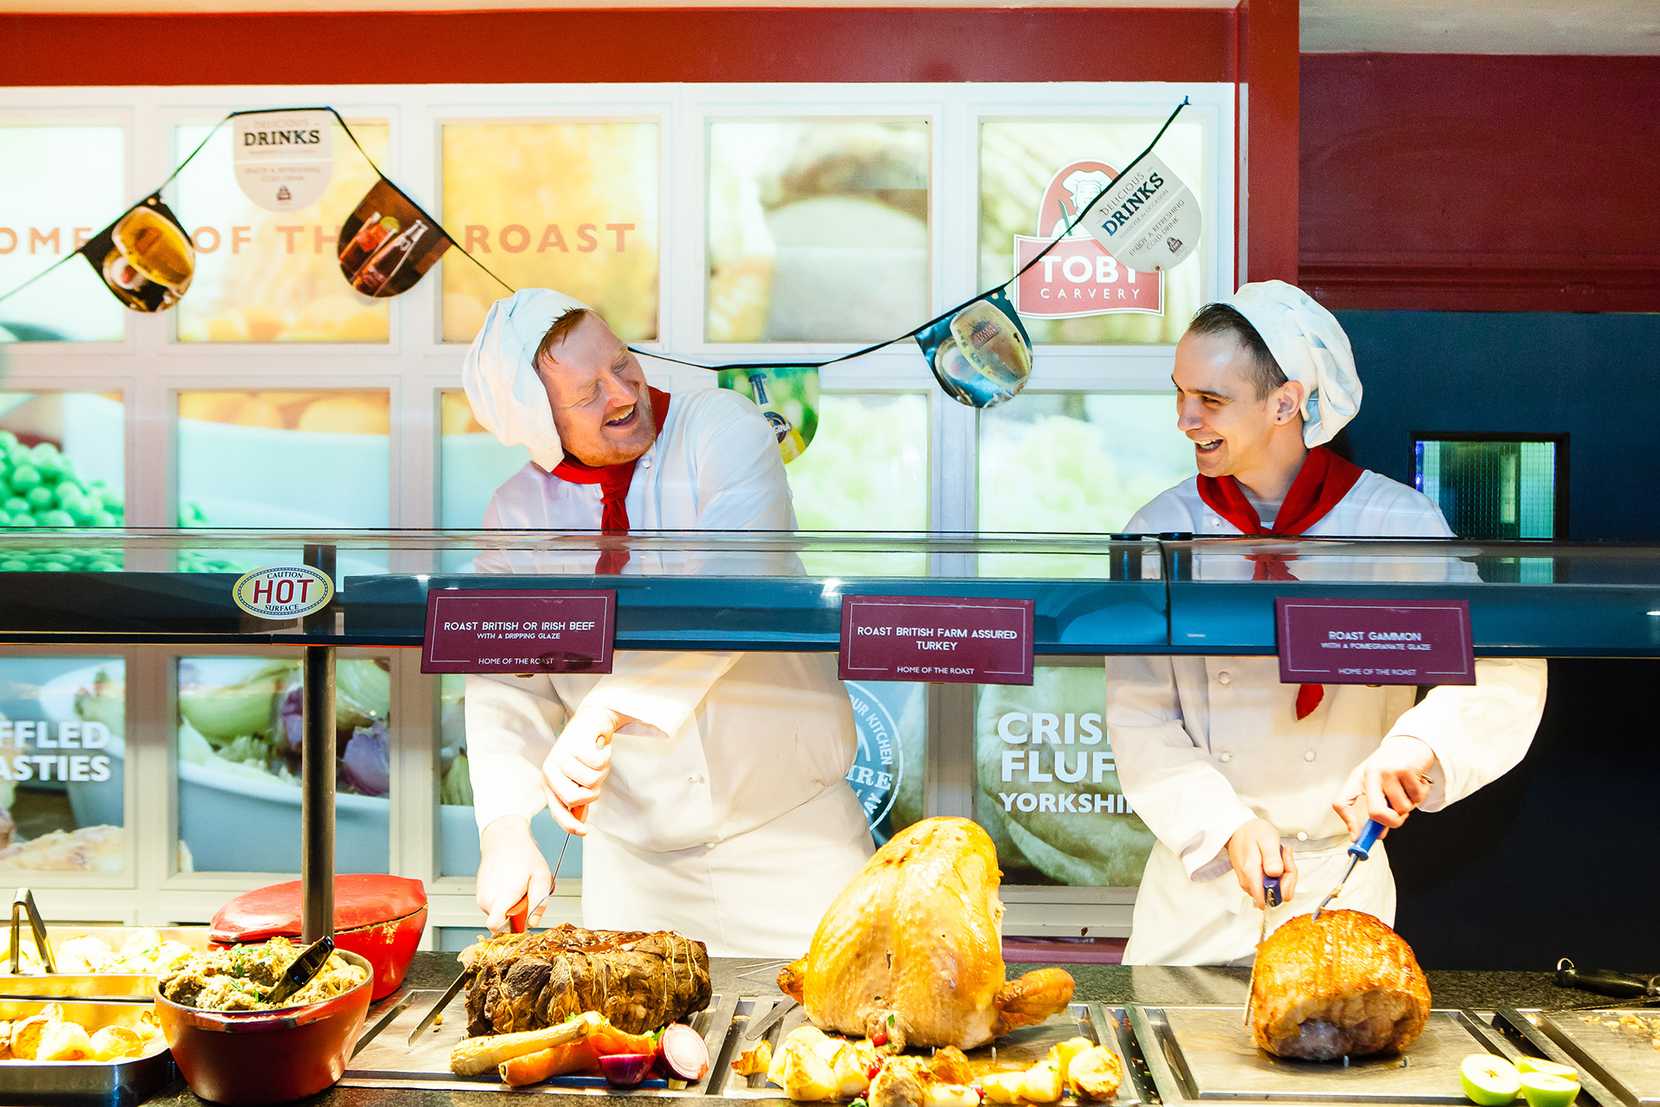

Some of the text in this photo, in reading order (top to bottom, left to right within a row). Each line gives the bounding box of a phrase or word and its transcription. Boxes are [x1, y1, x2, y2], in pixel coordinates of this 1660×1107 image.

[244, 130, 320, 146] DRINKS
[1101, 171, 1165, 237] DRINKS
[192, 226, 252, 254] OF
[464, 223, 635, 253] ROAST
[1040, 288, 1141, 299] CARVERY
[267, 571, 304, 580] CAUTION
[253, 579, 314, 604] HOT
[264, 604, 299, 612] SURFACE
[444, 621, 596, 631] ROAST BRITISH OR IRISH BEEF
[857, 627, 1018, 640] ROAST BRITISH FARM ASSURED
[1328, 631, 1422, 641] ROAST GAMMON
[916, 640, 958, 651] TURKEY
[897, 666, 919, 674] HOME
[950, 667, 975, 675] ROAST
[1376, 668, 1390, 676] THE
[865, 712, 893, 765] KITCHEN
